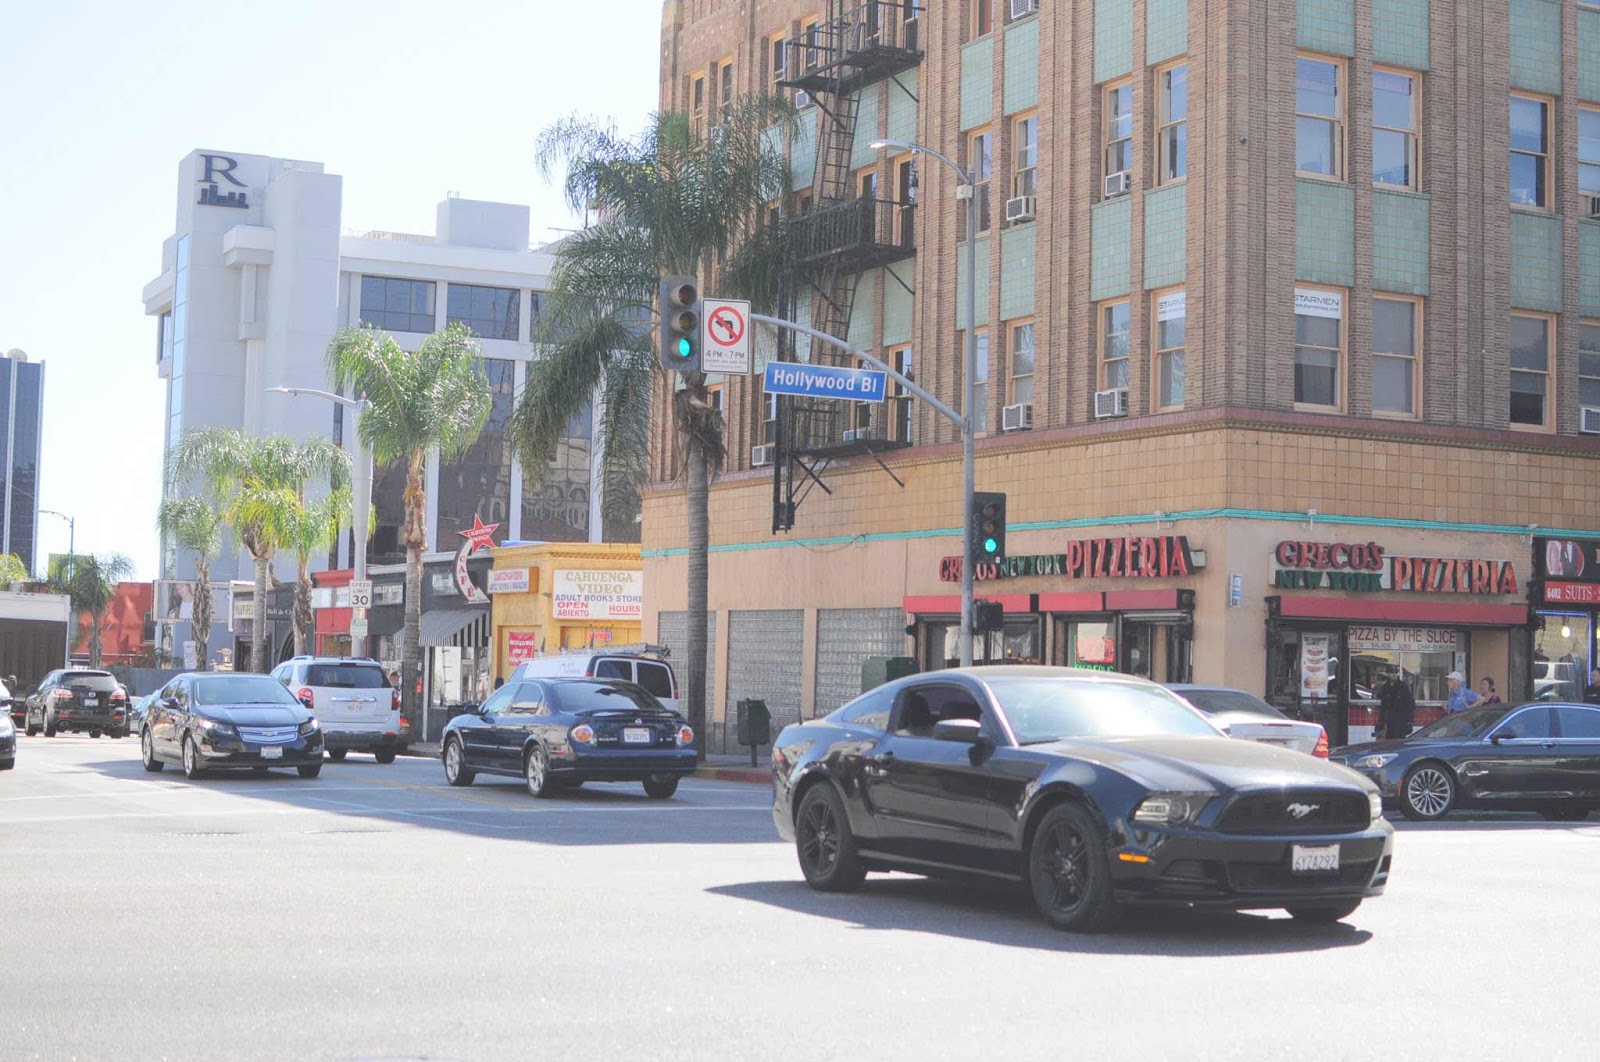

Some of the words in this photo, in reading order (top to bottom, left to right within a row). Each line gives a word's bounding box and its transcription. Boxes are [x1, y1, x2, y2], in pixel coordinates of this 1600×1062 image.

[197, 153, 248, 187] R
[1295, 294, 1340, 306] STARMEN
[713, 350, 722, 358] PM
[729, 350, 734, 358] 7
[773, 369, 855, 391] Hollywood
[861, 376, 878, 393] Bl
[1067, 536, 1189, 580] PIZZERIA
[1276, 540, 1385, 571] GRECO'S
[1001, 556, 1026, 577] NEW
[1029, 555, 1062, 576] YORK
[565, 572, 634, 583] CAHUENGA
[1275, 570, 1323, 589] NEW
[1326, 571, 1383, 592] YORK
[1394, 557, 1518, 594] PIZZERIA
[577, 583, 624, 594] VIDEO
[1565, 585, 1593, 600] SUITS
[352, 595, 369, 605] 30
[555, 594, 582, 602] ADULT
[616, 595, 643, 603] STORE
[557, 609, 590, 617] ABIERTO
[609, 605, 641, 613] HOURS
[1348, 627, 1379, 641] PIZZA
[1384, 628, 1397, 641] BY
[1402, 628, 1422, 642] THE
[1427, 630, 1456, 644] SLICE
[1457, 655, 1463, 664] A
